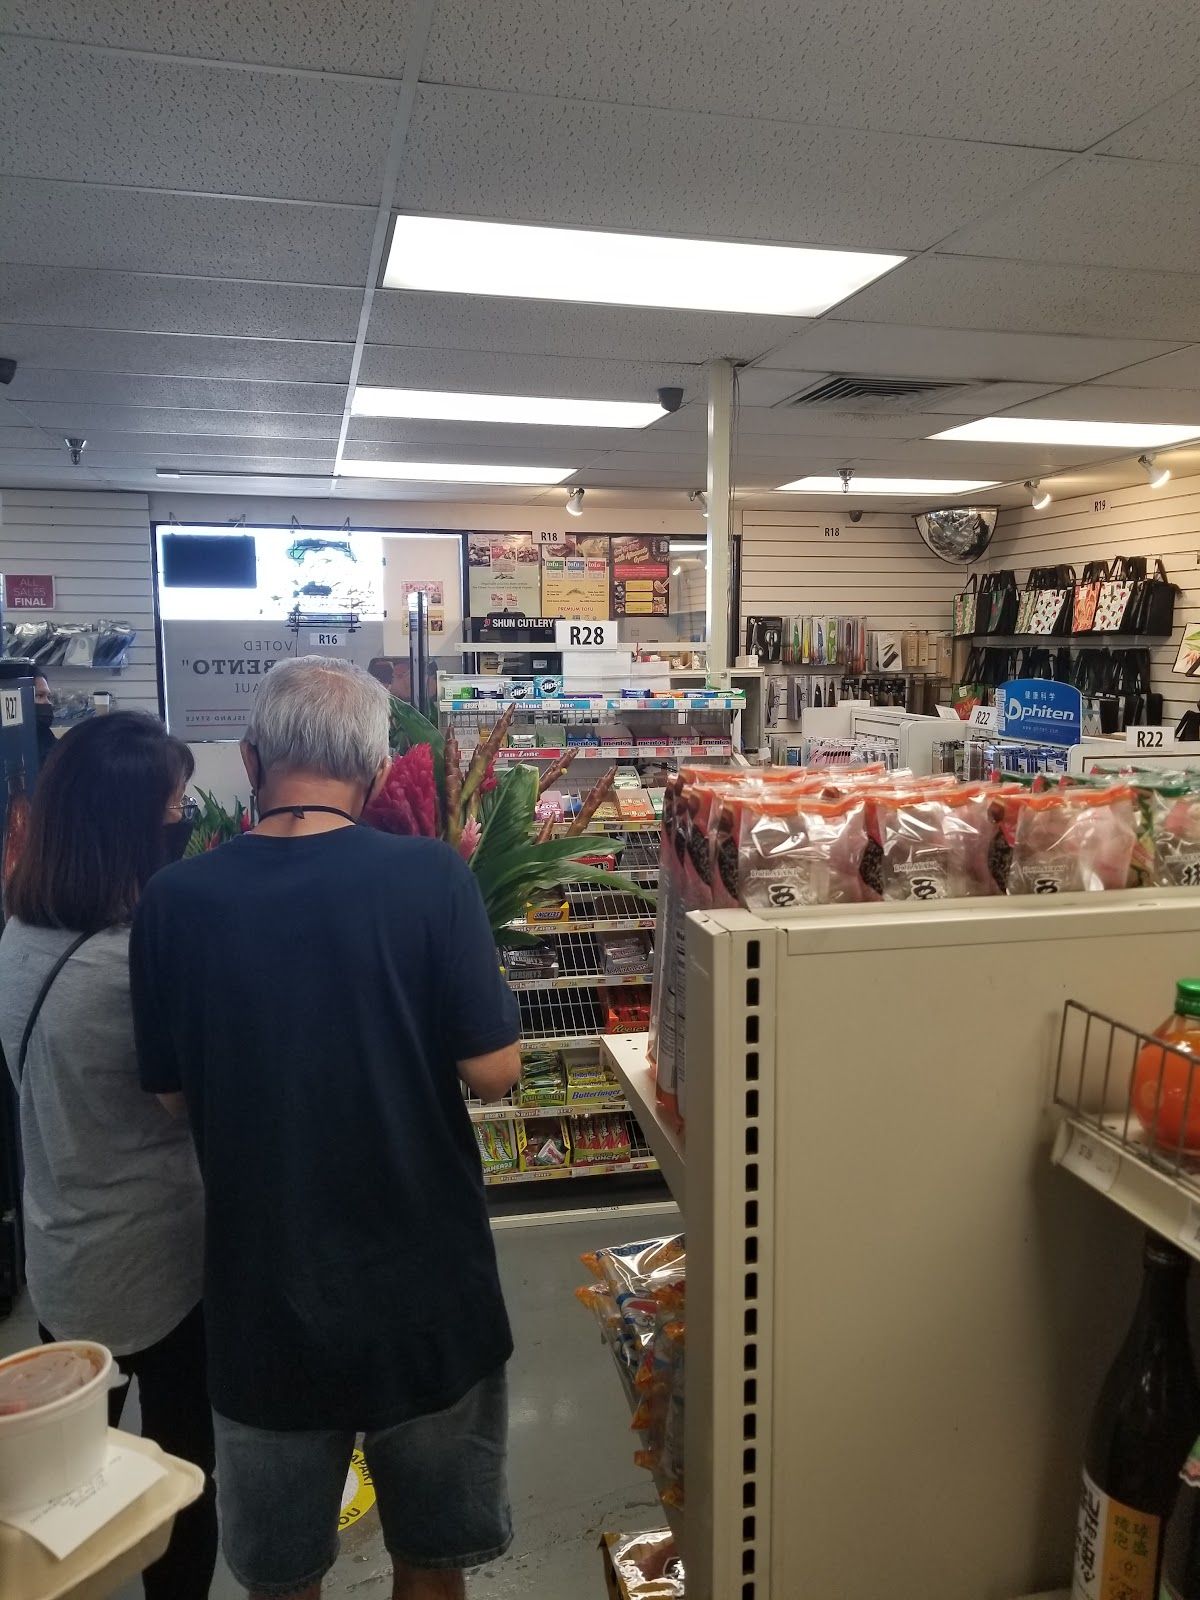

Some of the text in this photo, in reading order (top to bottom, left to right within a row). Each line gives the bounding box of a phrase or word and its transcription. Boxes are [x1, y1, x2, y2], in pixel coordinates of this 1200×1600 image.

[1094, 500, 1106, 512] R19
[541, 532, 558, 541] R18
[824, 527, 841, 538] R18
[19, 578, 37, 586] ALL
[14, 588, 46, 597] SALES
[14, 597, 47, 606] FINAL
[492, 618, 554, 628] SHUN CUTLERY
[319, 634, 338, 645] R16
[570, 626, 605, 645] R28
[975, 711, 991, 725] R22
[1021, 704, 1075, 722] phiten
[1136, 731, 1163, 748] R22
[534, 911, 563, 919] SNICKERS
[572, 1089, 621, 1100] Butterfinger
[587, 1154, 620, 1162] PUNCH
[338, 1507, 361, 1525] OU
